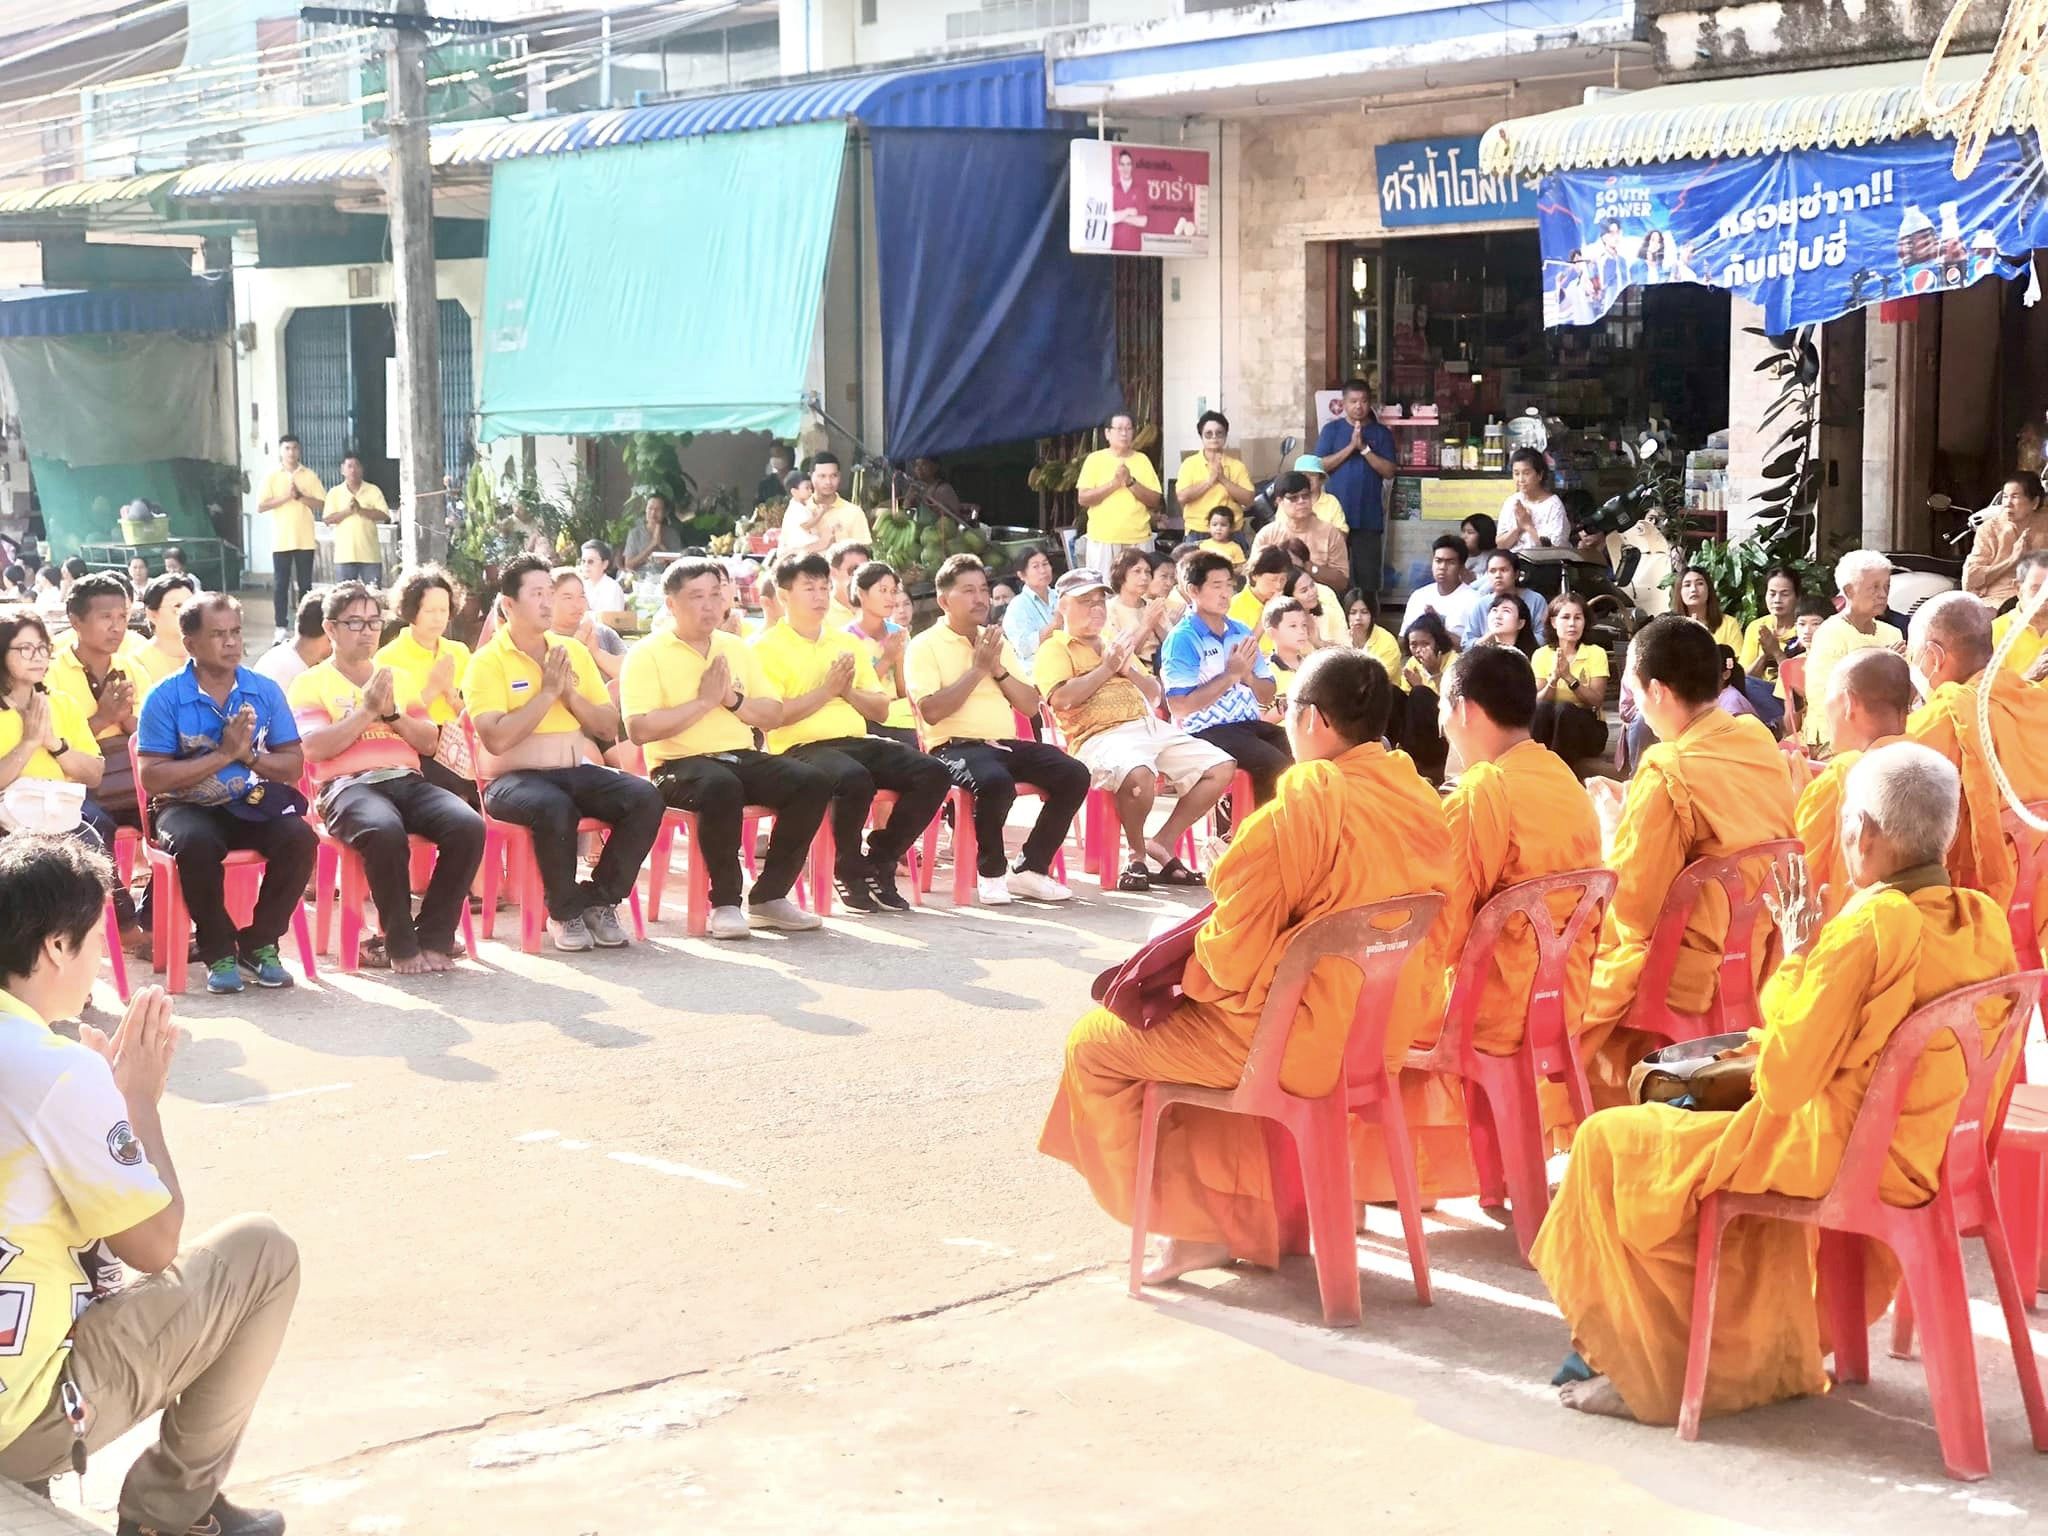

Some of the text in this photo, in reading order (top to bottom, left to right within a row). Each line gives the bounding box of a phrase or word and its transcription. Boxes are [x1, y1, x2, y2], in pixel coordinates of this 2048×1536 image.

[1147, 176, 1194, 202] ซาร่า
[1595, 188, 1650, 207] SOUTH
[1593, 202, 1652, 224] POWER
